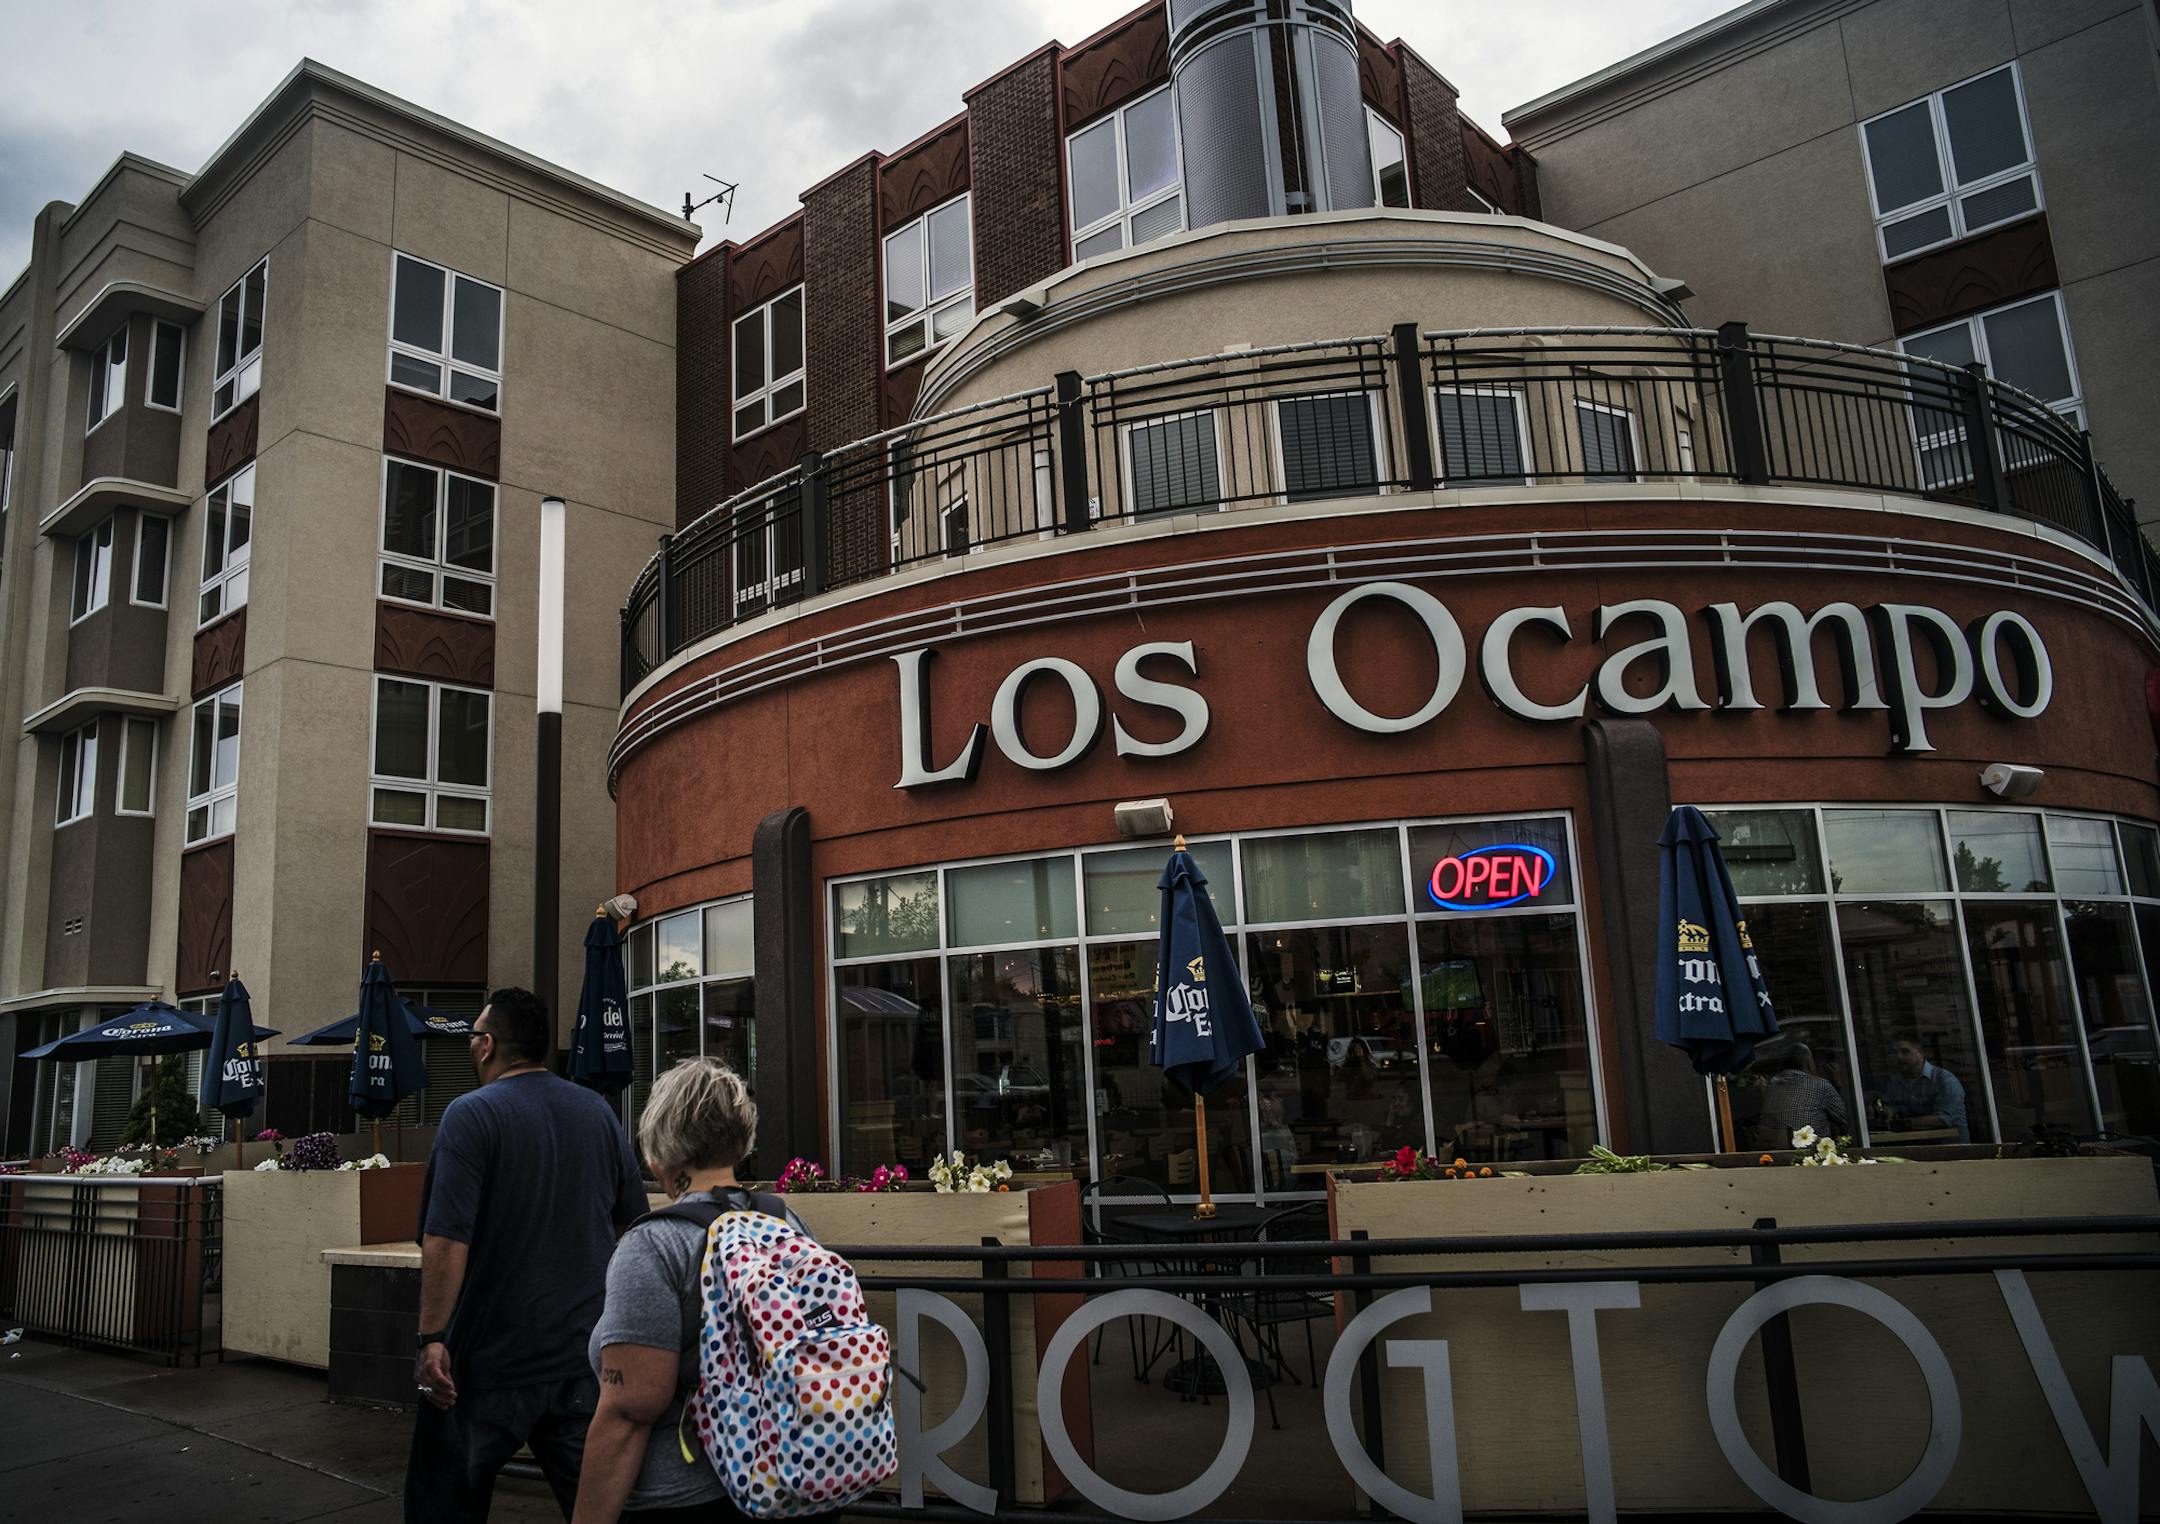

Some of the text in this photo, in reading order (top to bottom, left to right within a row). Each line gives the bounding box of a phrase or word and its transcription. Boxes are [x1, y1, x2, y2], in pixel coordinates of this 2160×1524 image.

[889, 582, 2053, 789] Los Ocampo
[1432, 856, 1542, 899] OPEN
[101, 1025, 173, 1037] Corona
